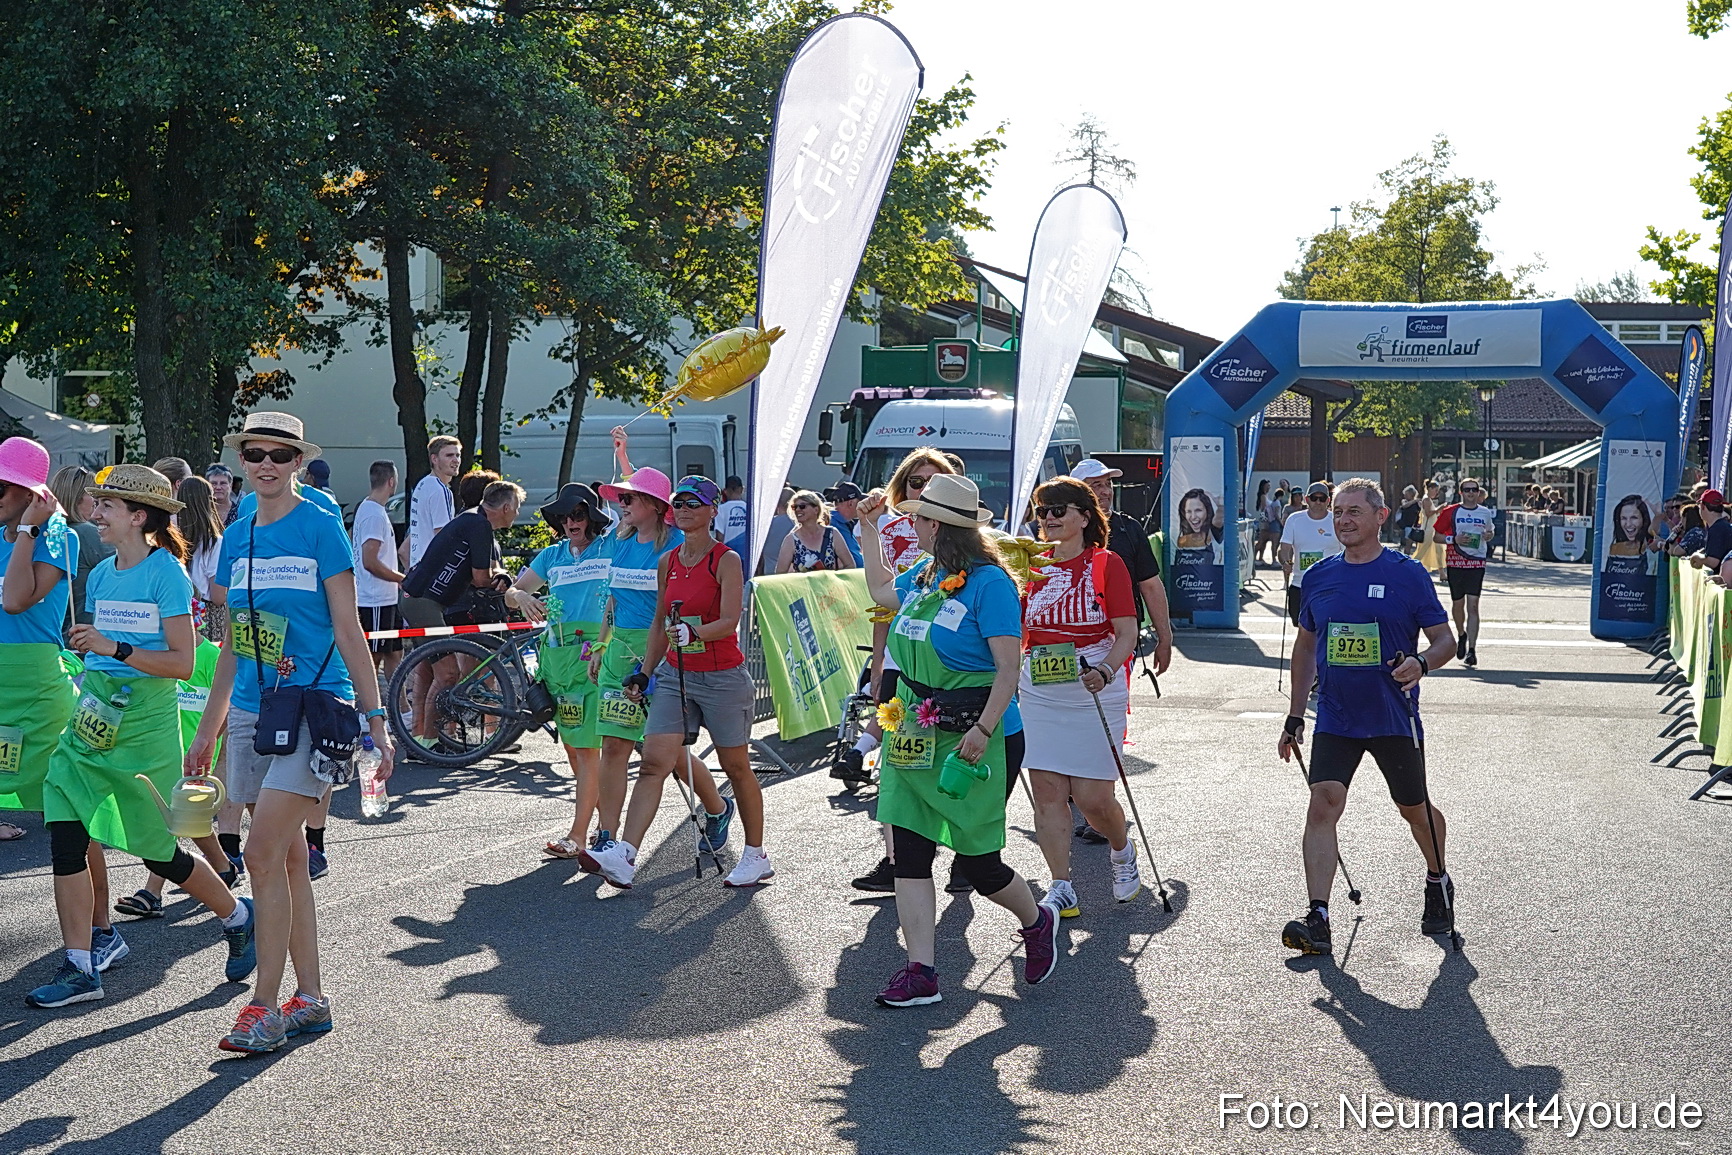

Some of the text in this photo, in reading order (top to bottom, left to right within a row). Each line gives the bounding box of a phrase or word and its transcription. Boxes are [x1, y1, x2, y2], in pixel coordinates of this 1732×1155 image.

[813, 53, 879, 197] Fischer
[845, 73, 892, 190] AUTOMOBILE
[1414, 323, 1445, 331] Fischer
[1391, 338, 1482, 356] firmenlauf
[769, 277, 844, 479] www.fischer-automobile.de
[1219, 366, 1267, 377] Fischer
[1583, 366, 1597, 374] das
[875, 426, 916, 435] abavent
[1019, 362, 1071, 499] www.fischer-automobile.de
[251, 564, 309, 575] Freie Grundschule
[573, 563, 607, 573] Grundschule
[626, 573, 656, 581] Grundschule
[1181, 579, 1213, 587] Fischer
[1611, 589, 1645, 598] Fischer
[98, 607, 151, 619] Freie Grundschule
[1337, 637, 1366, 653] 973
[1035, 656, 1067, 673] 1121
[1068, 658, 1076, 677] 2022
[560, 705, 579, 717] 1443
[605, 700, 637, 717] 1429
[79, 709, 108, 739] 1442
[104, 727, 115, 748] 2022
[891, 736, 925, 754] 1445
[9, 746, 18, 769] 2022
